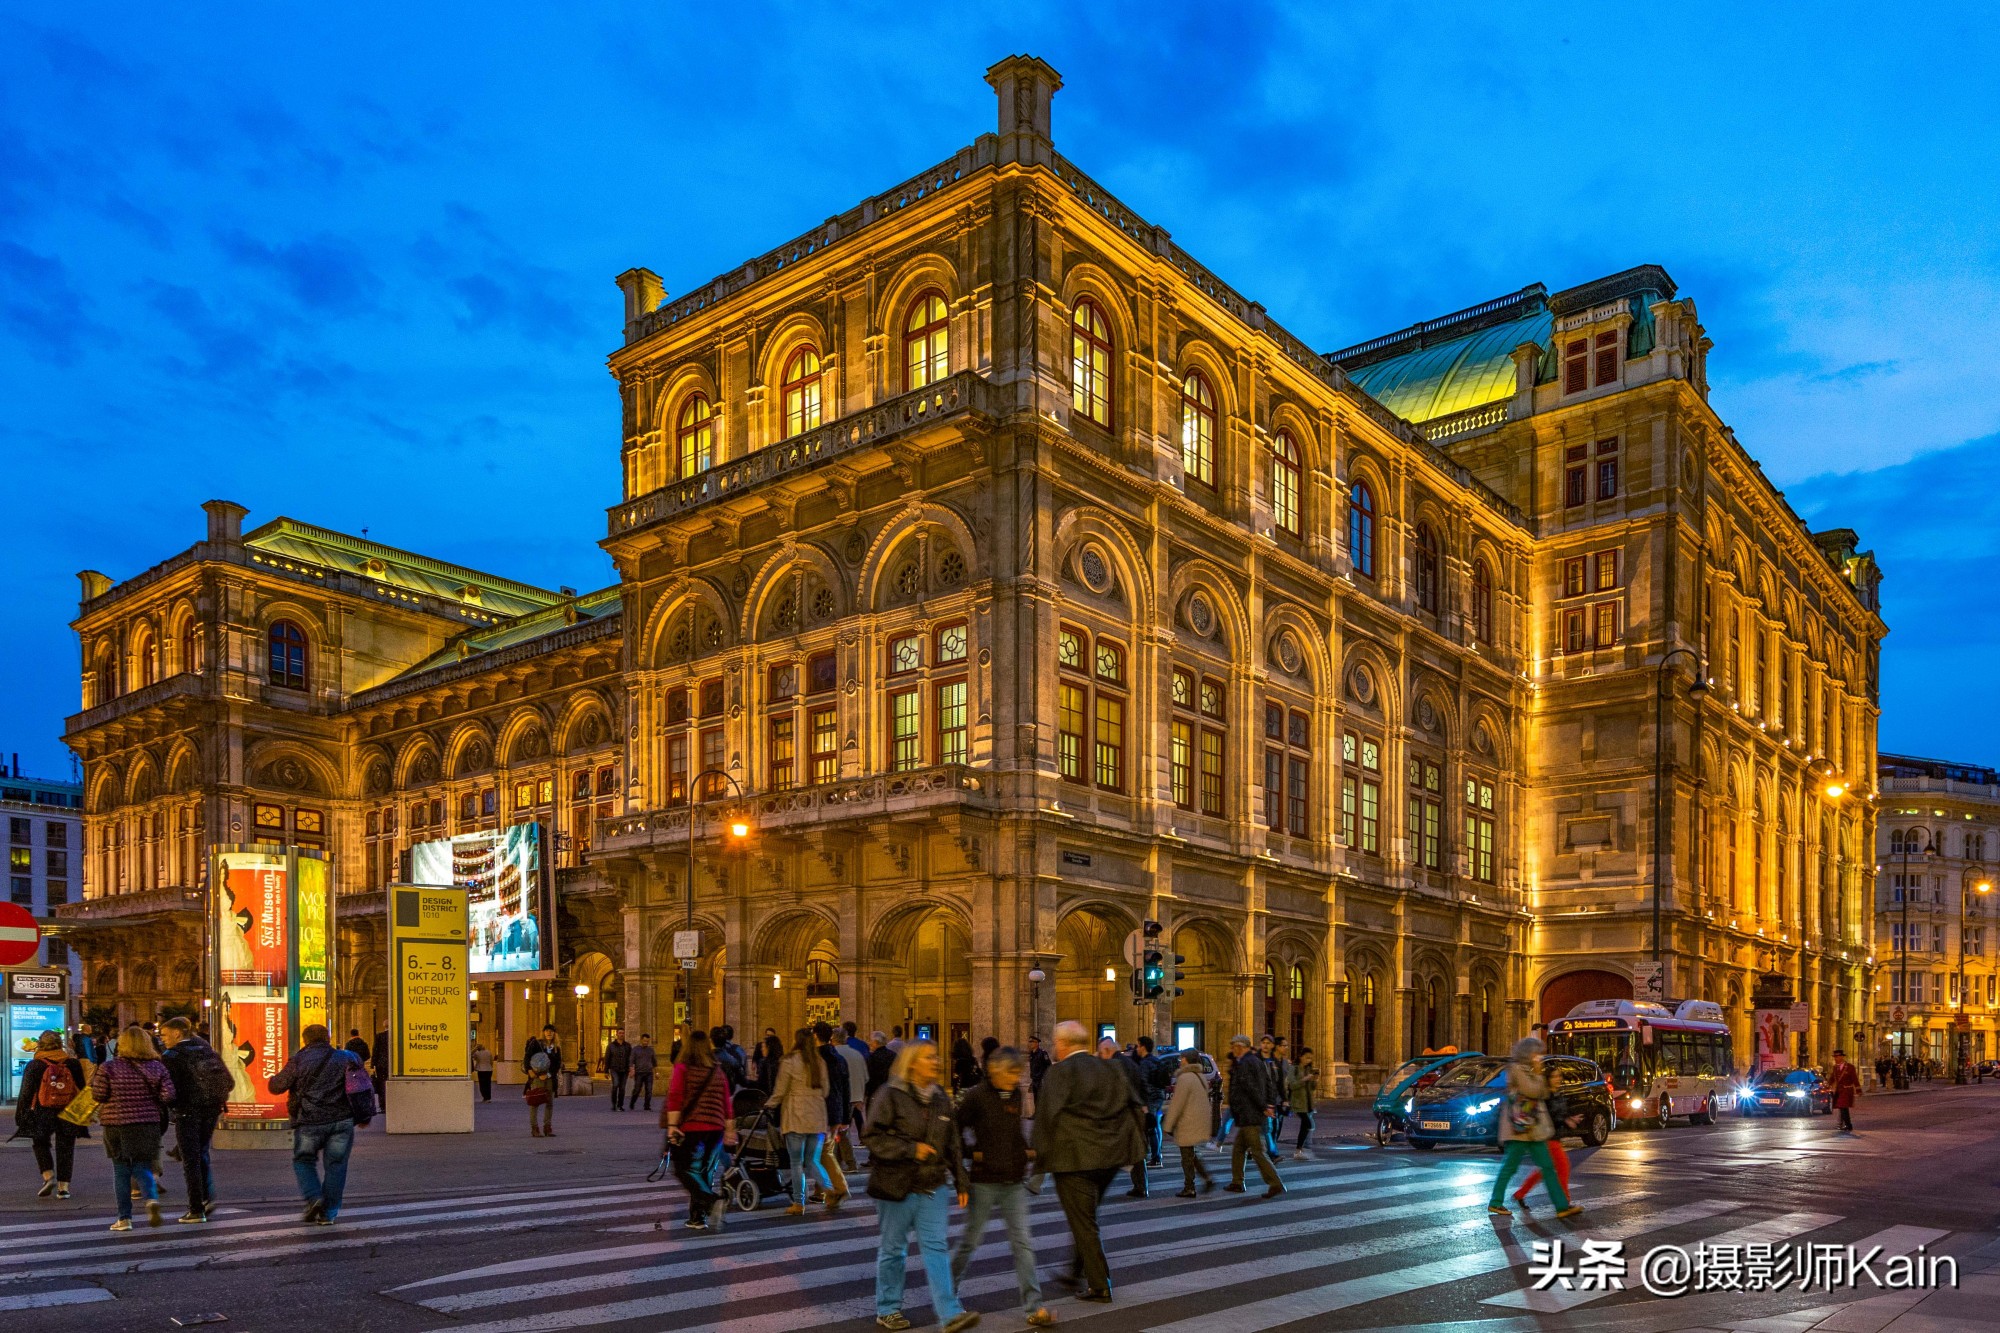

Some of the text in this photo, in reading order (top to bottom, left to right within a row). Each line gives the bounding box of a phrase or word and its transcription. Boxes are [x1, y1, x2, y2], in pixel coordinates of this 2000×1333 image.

[262, 874, 274, 948] Sisi Museum
[408, 955, 422, 969] 6.
[442, 956, 456, 970] 8.
[408, 972, 456, 981] OKT 2017
[408, 986, 459, 995] HOFBURG
[304, 996, 326, 1009] BRU
[409, 996, 448, 1005] VIENNA
[409, 1023, 437, 1032] Living
[409, 1033, 449, 1042] Lifestyle
[262, 1007, 276, 1079] Sisi Museum
